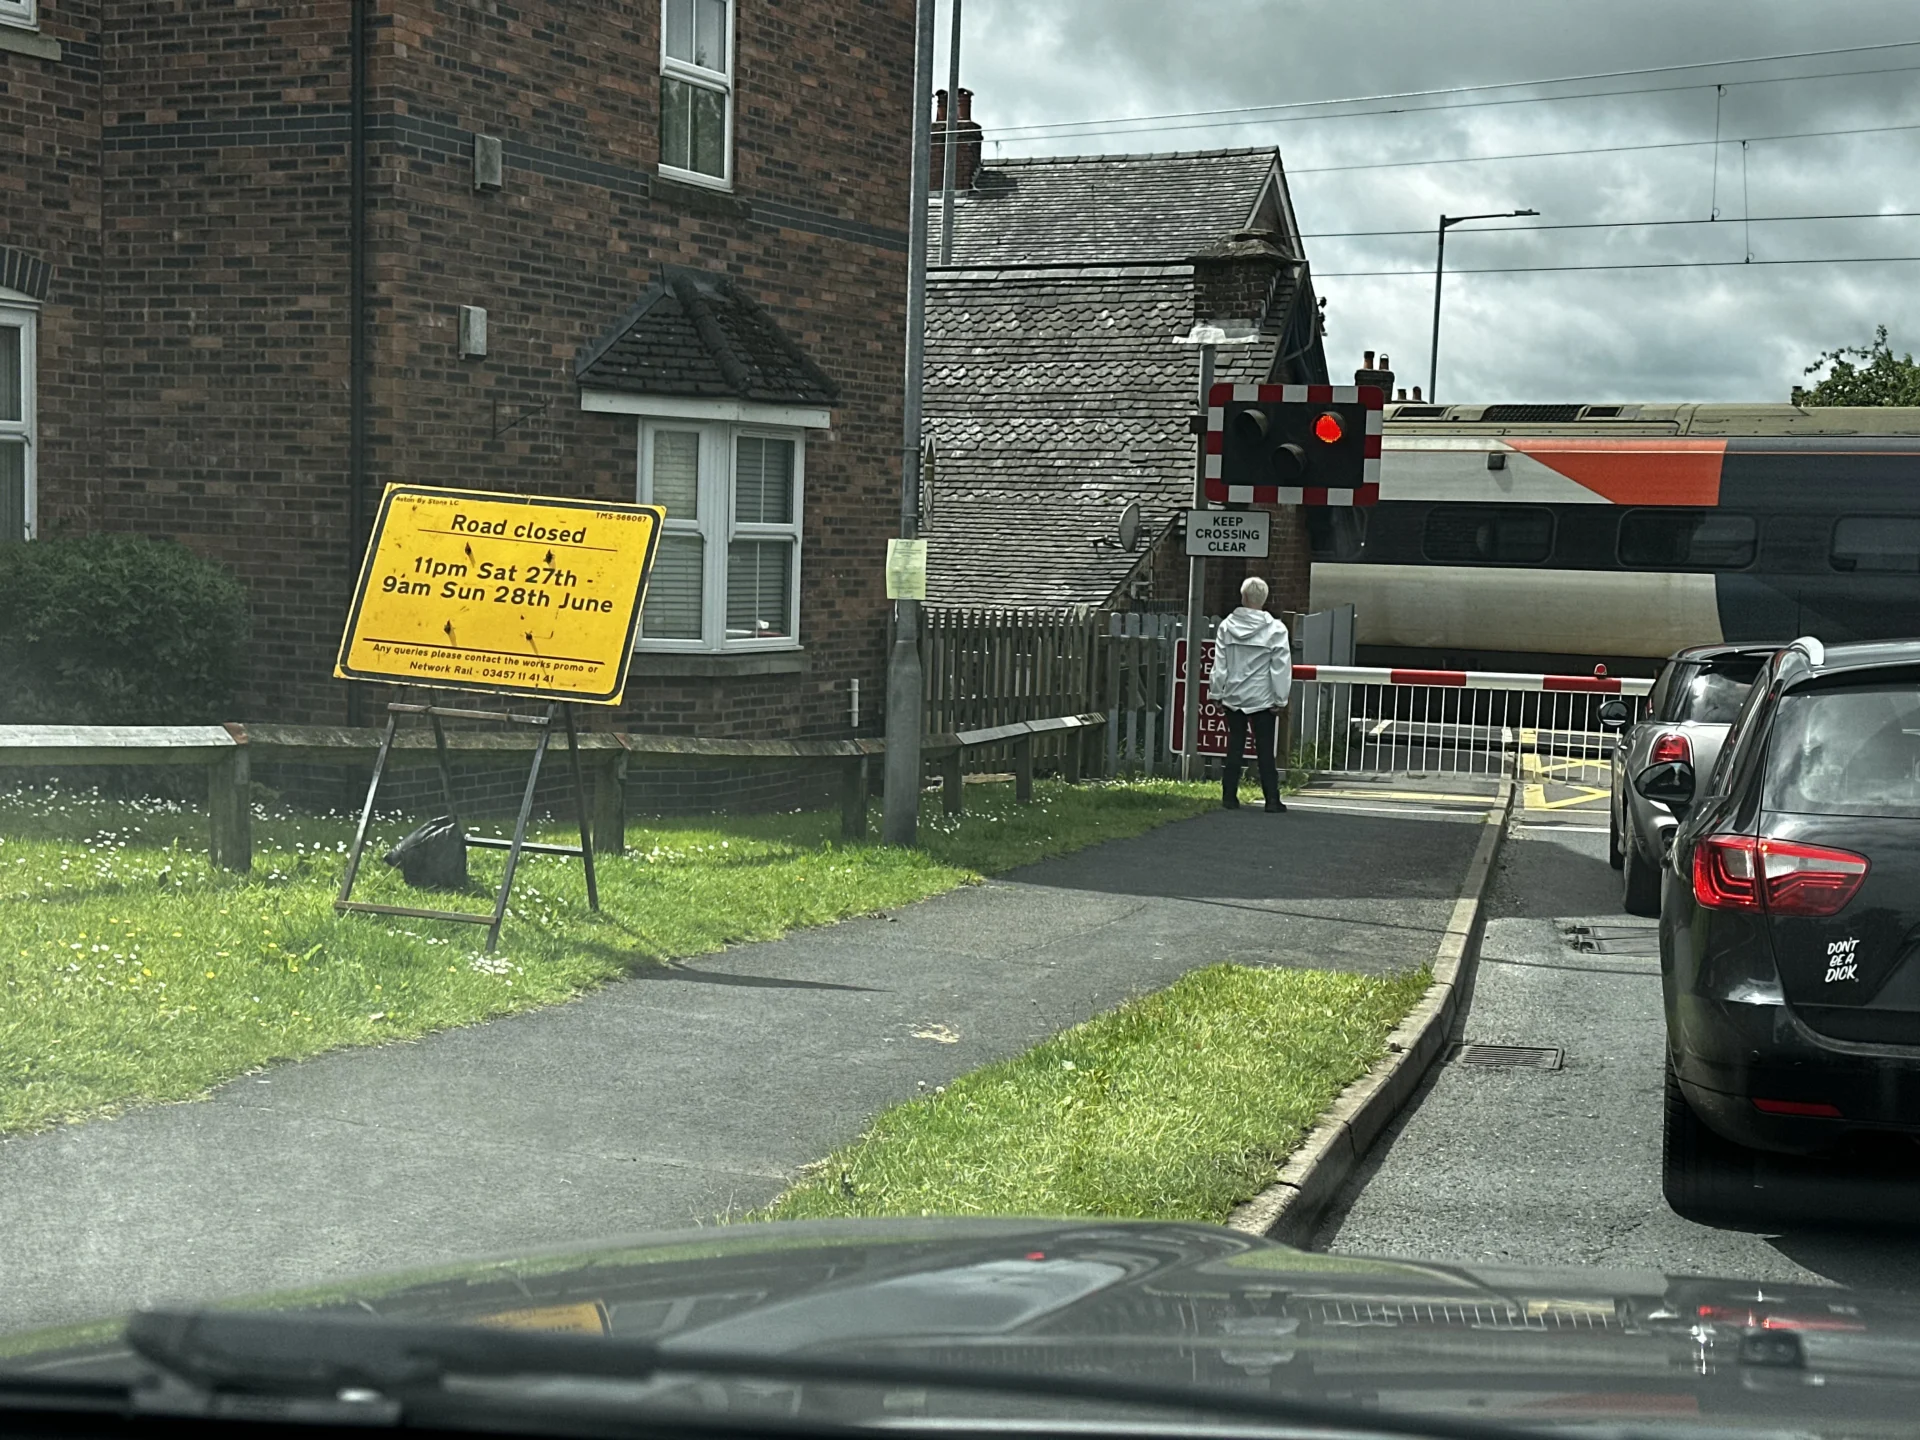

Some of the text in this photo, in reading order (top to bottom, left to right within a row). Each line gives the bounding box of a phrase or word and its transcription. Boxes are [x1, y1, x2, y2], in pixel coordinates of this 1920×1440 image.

[451, 514, 586, 544] Road closed
[1213, 516, 1243, 526] KEEP
[1195, 528, 1260, 540] CROSSING
[1208, 541, 1246, 552] CLEAR
[414, 556, 468, 578] 11pm
[477, 562, 517, 582] Sat
[525, 566, 577, 587] 27th
[382, 575, 613, 613] 9am Sun 28th June
[372, 643, 598, 674] Any queries please contact the works promo or
[409, 661, 451, 673] Network
[454, 665, 473, 675] Rail
[482, 668, 515, 679] 03457
[517, 671, 526, 680] 11
[529, 672, 540, 682] 41
[544, 674, 554, 683] 41
[1827, 937, 1860, 955] DON'T
[1829, 953, 1855, 967] BE A
